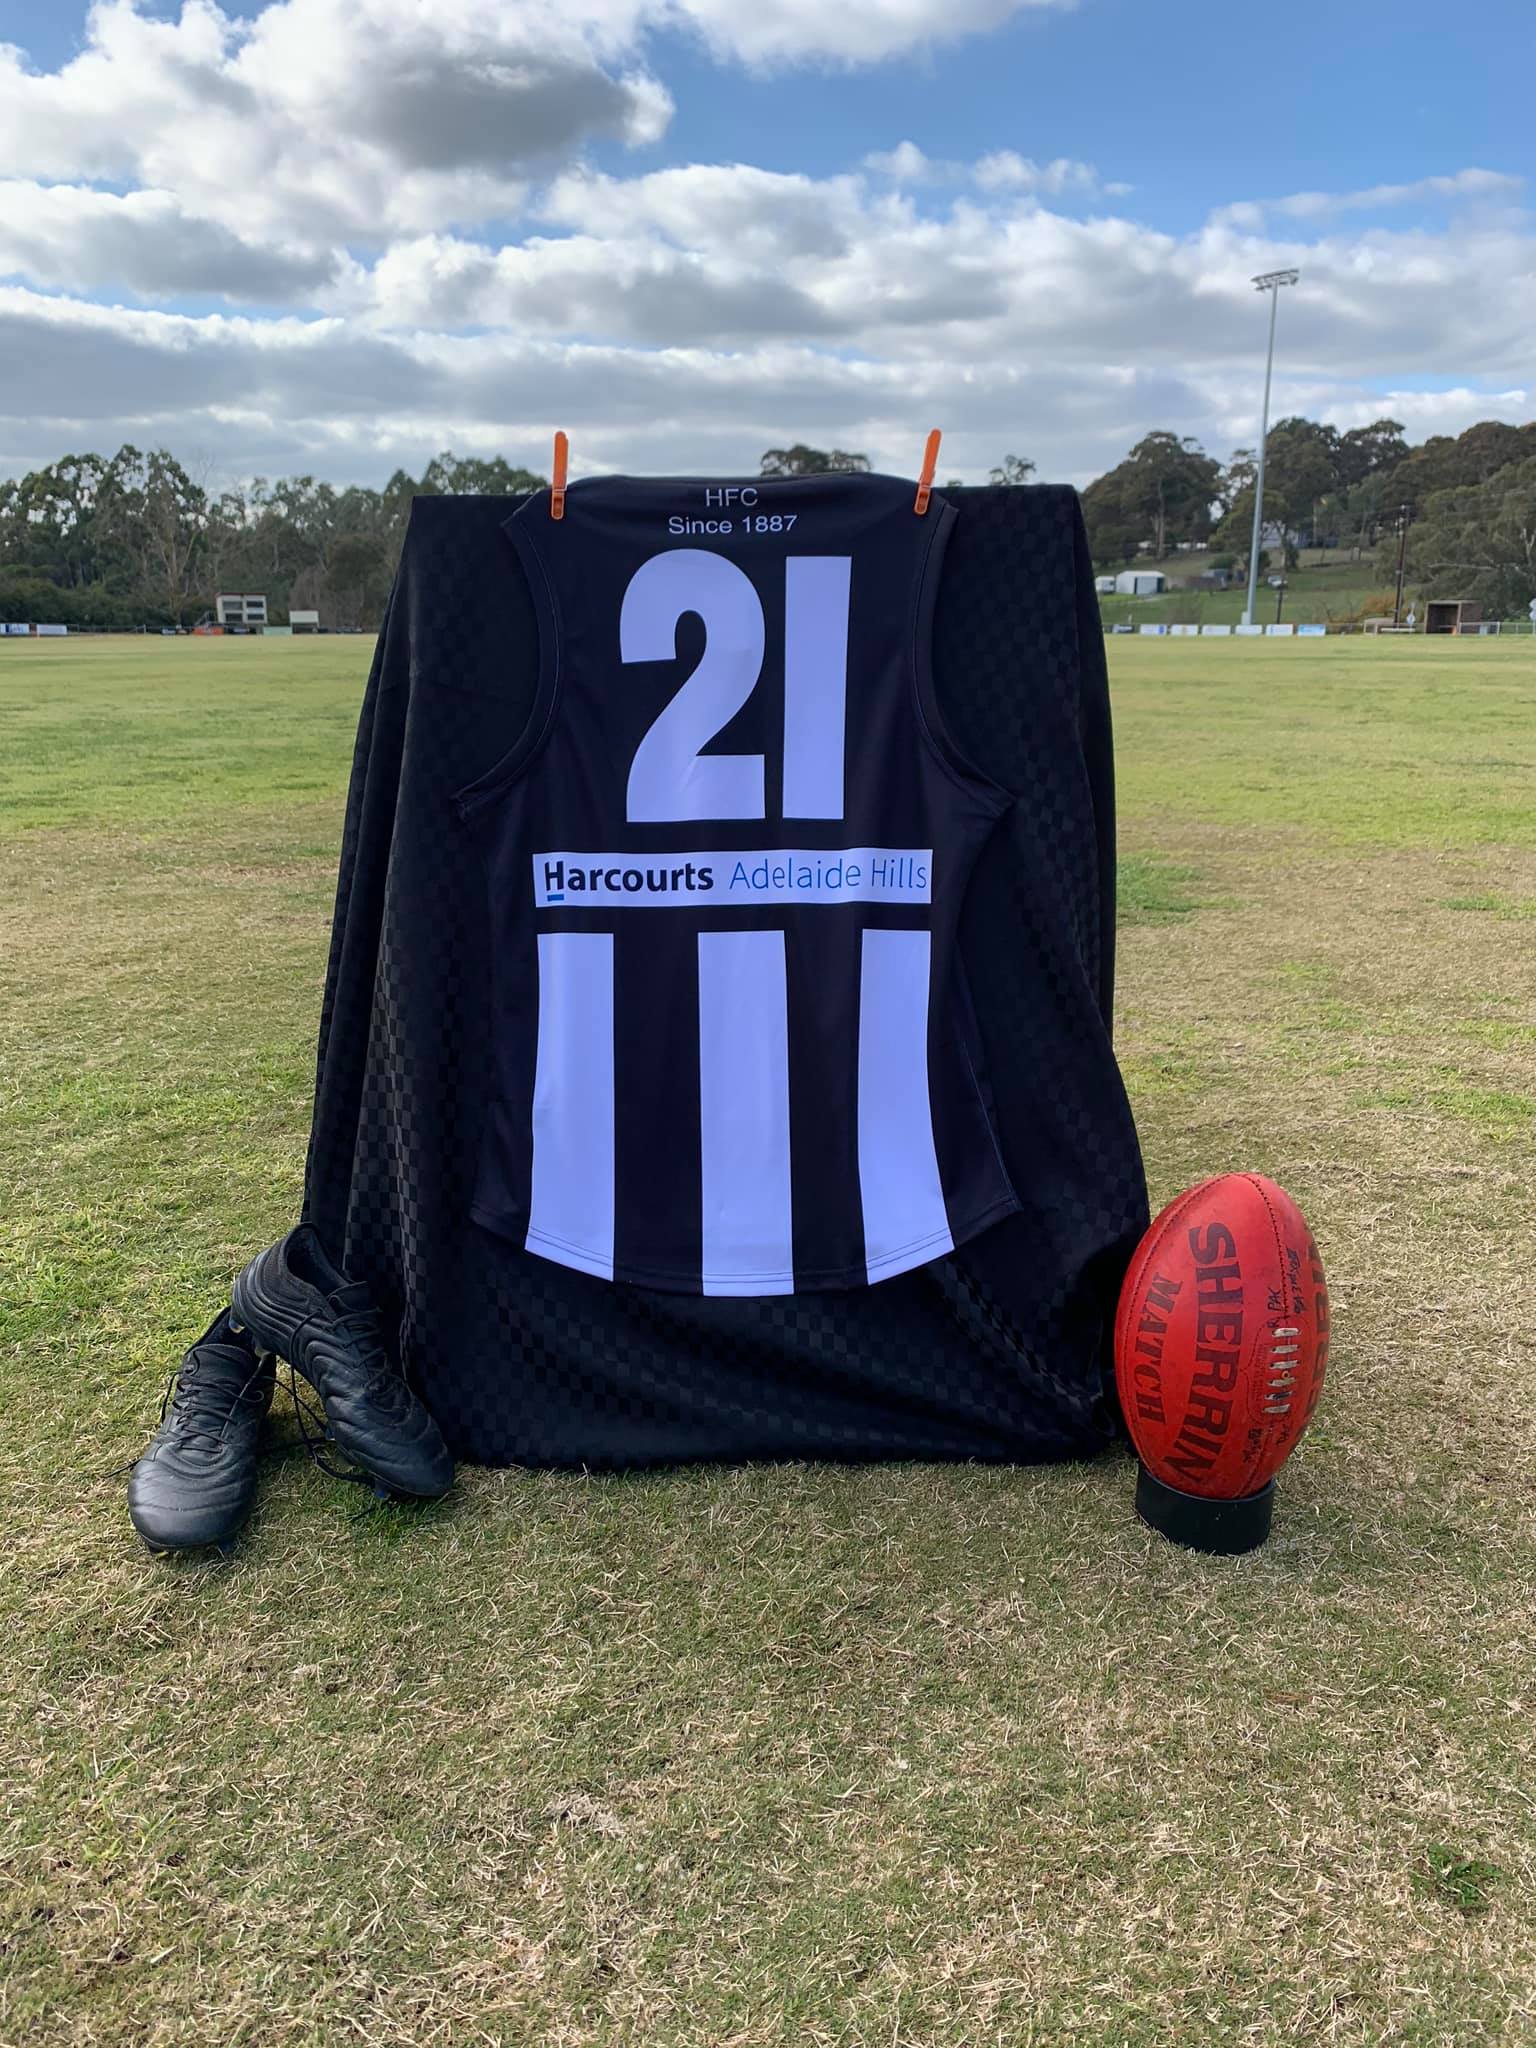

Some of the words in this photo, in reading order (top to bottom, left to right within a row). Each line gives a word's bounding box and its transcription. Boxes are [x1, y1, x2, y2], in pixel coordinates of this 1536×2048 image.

[668, 516, 733, 535] Since
[742, 514, 798, 534] 1887
[705, 487, 759, 507] HFC
[619, 548, 852, 823] 21
[544, 860, 714, 893] Harcourts
[729, 857, 862, 889] Adelaide
[871, 856, 928, 889] Hills
[1133, 1271, 1183, 1425] MATCH
[1162, 1222, 1244, 1483] SHERRIN
